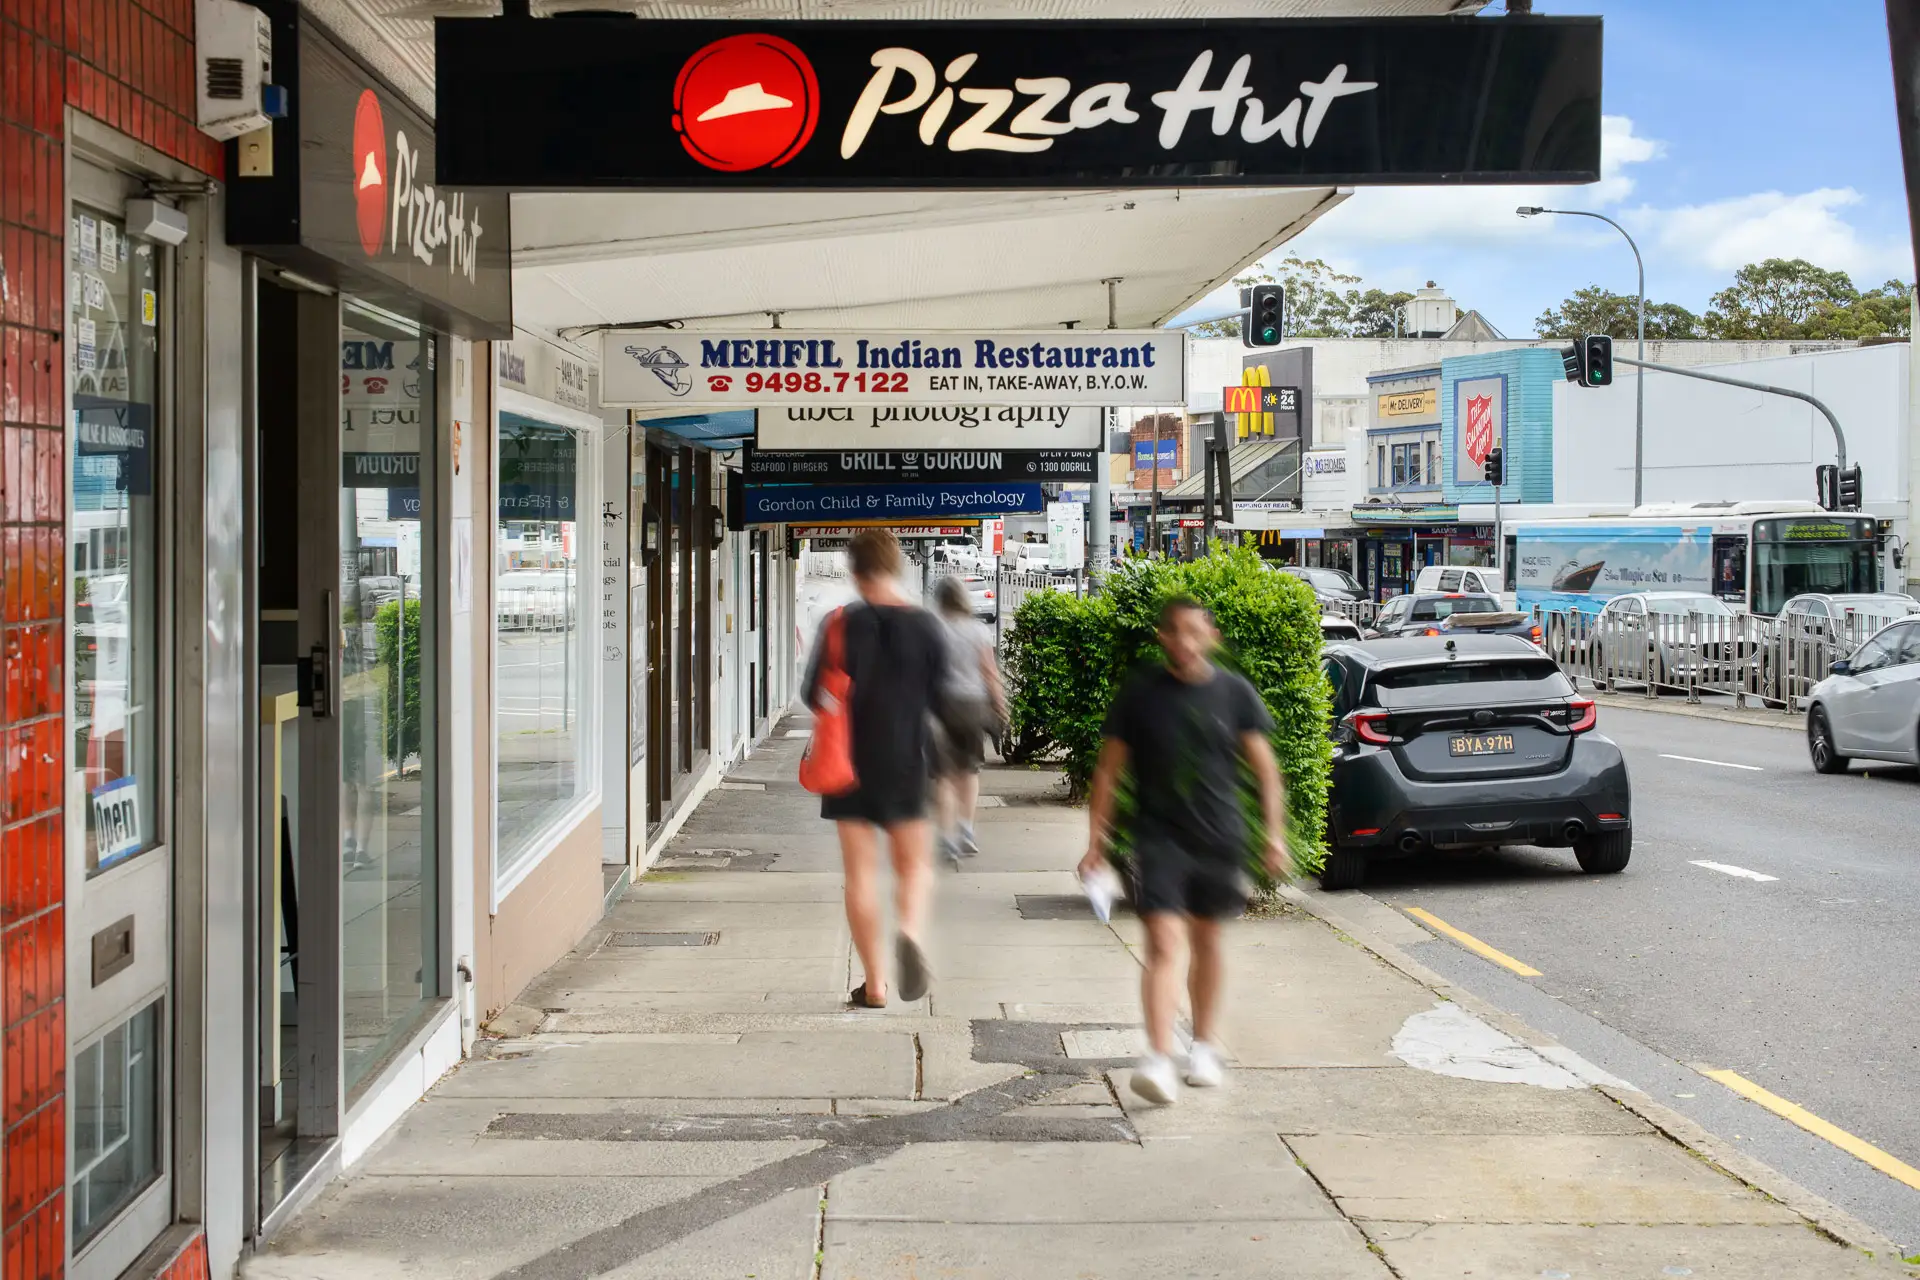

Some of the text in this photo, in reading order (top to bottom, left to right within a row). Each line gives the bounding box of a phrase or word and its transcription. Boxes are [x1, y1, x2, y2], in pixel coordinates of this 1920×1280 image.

[840, 46, 1379, 160] Pizza Hut
[391, 130, 483, 286] Pizza Hut
[700, 339, 1155, 369] MEHFIL Indian Restaurant
[745, 371, 1148, 393] 9498.7122 EAT IN, TAKE-AWAY, B.Y.O.W.
[1280, 394, 1295, 405] 24
[1398, 397, 1423, 410] DELIVERY
[1470, 398, 1482, 423] THE
[1467, 402, 1492, 450] SALVATION
[1475, 424, 1491, 460] ARMY
[751, 462, 785, 472] SEAFOOD
[793, 462, 828, 472] BURGERS
[840, 452, 896, 470] GRILL
[923, 452, 1003, 470] GORDON
[1040, 462, 1059, 472] 1300
[758, 491, 1026, 512] Gordon Child & Family Psychology
[1652, 570, 1668, 583] Sea
[96, 798, 138, 853] Open
